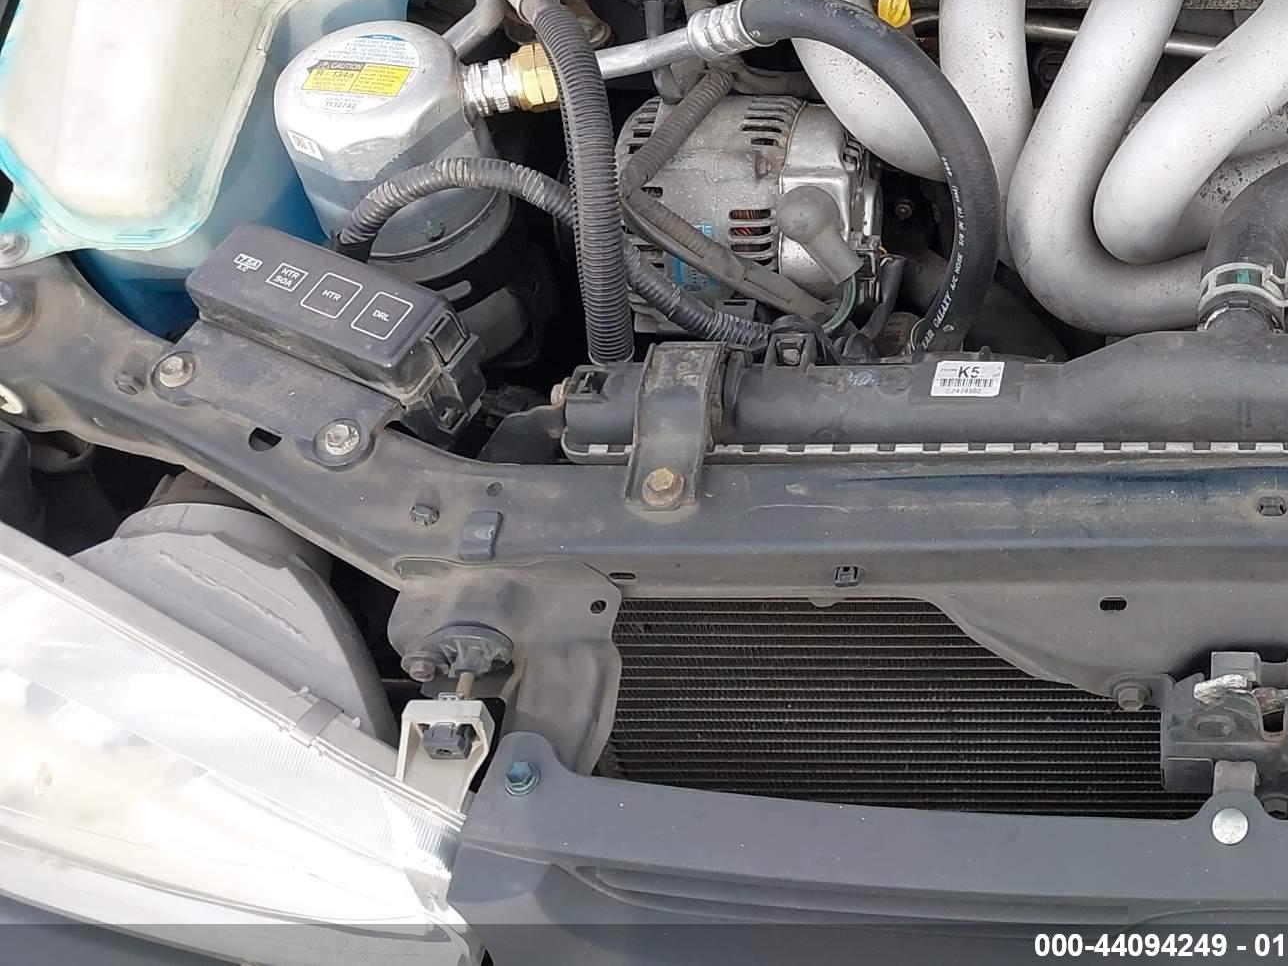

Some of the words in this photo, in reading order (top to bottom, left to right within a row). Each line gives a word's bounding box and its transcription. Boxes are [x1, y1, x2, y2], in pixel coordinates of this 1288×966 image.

[331, 62, 363, 71] CAUTION
[280, 267, 300, 280] HTR
[273, 275, 293, 288] 50A
[321, 289, 342, 302] HTR
[933, 291, 954, 328] GALAXY
[954, 252, 964, 275] HOSE
[372, 309, 390, 323] DRL
[958, 366, 981, 379] K5
